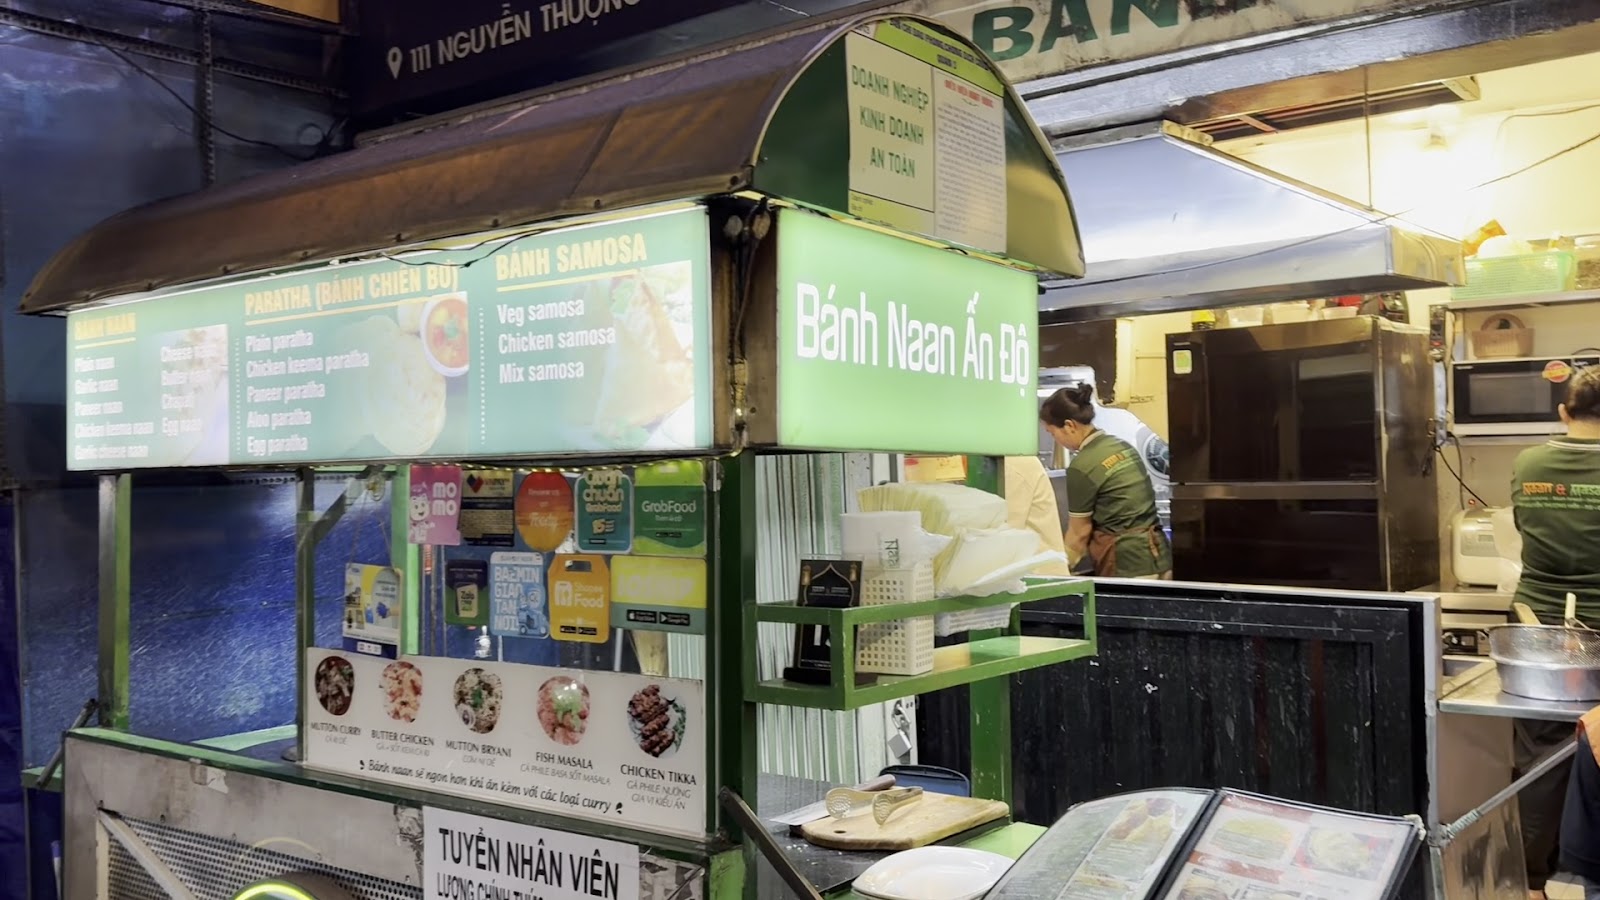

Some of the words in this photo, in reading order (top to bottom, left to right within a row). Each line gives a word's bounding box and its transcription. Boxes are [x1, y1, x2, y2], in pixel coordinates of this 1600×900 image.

[410, 44, 432, 73] 111
[438, 3, 531, 65] NGUYỄN
[540, 0, 641, 32] THƯỢ
[852, 64, 889, 97] DOANH
[893, 80, 929, 113] NGHIỆP
[859, 105, 885, 132] KINH
[889, 116, 924, 145] DOANH
[870, 147, 884, 169] AN
[888, 152, 915, 178] TOÀN
[495, 246, 550, 280] BÁNH
[557, 232, 647, 273] SAMOSA
[245, 284, 311, 316] PARATHA
[497, 304, 525, 327] Veg
[528, 299, 584, 321] samosa
[498, 333, 553, 354] Chicken
[558, 326, 616, 348] samosa
[796, 282, 878, 366] Bánh
[888, 301, 955, 376] Naan
[962, 291, 993, 381] Ấn
[999, 323, 1029, 397] Độ
[499, 363, 525, 384] Mix
[528, 361, 584, 380] samosa
[642, 500, 696, 512] GrabFood
[575, 593, 604, 608] Food
[371, 729, 398, 741] BUTTER
[400, 733, 435, 746] CHICKEN
[446, 740, 479, 753] MUTTON
[536, 752, 555, 764] FISH
[558, 755, 593, 770] MASALA
[620, 764, 665, 780] CHICKEN
[668, 771, 697, 786] TIKKA
[369, 760, 389, 773] Bánh
[392, 766, 413, 777] naan
[425, 771, 448, 784] ngon
[501, 781, 521, 795] kèm
[523, 785, 538, 799] với
[540, 789, 557, 802] các
[560, 791, 580, 807] loại
[582, 797, 611, 814] curry
[438, 826, 500, 874] TUYỂN
[507, 838, 562, 888] NHÂN
[570, 848, 619, 900] VIÊN
